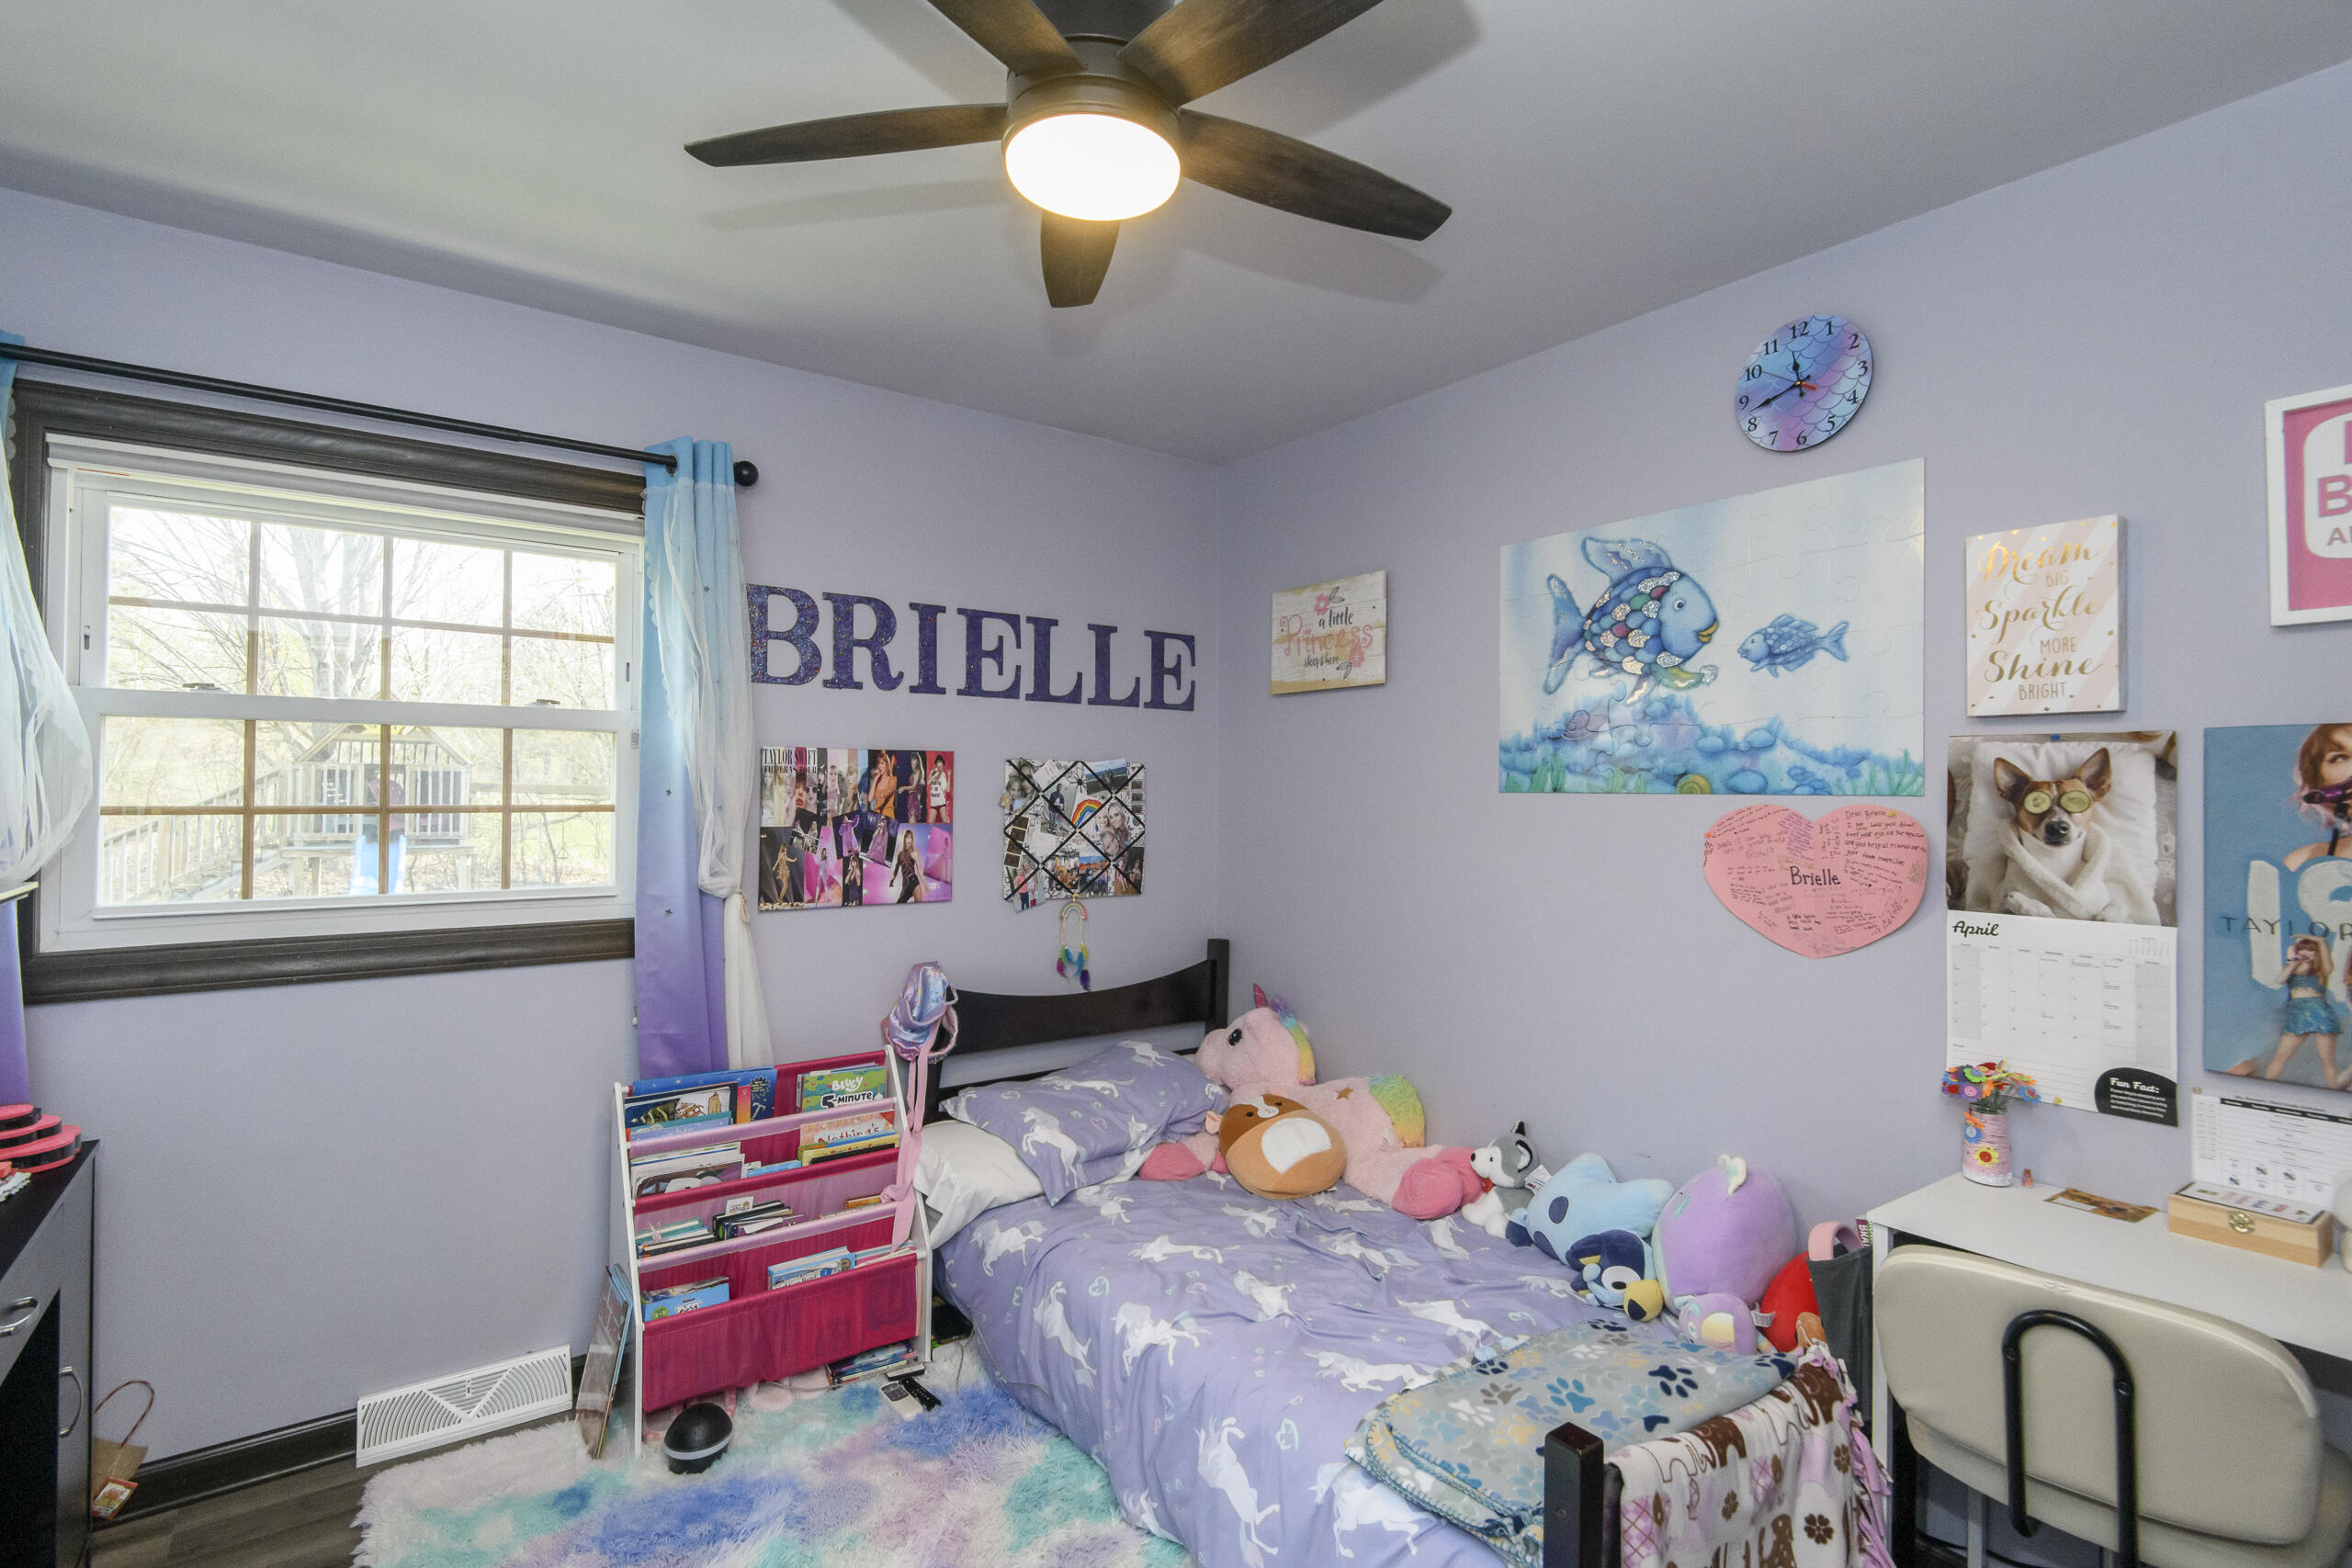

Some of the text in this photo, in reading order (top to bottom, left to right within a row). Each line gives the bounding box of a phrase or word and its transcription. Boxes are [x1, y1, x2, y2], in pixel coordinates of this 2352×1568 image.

[1792, 321, 1810, 340] 12
[1826, 321, 1833, 336] 1
[1763, 339, 1779, 356] 11
[1848, 333, 1860, 350] 2
[1746, 365, 1763, 382] 10
[1858, 360, 1869, 377] 3
[1739, 395, 1749, 411] 9
[1847, 389, 1859, 405] 4
[1747, 416, 1758, 432] 8
[1826, 416, 1836, 432] 5
[1769, 430, 1779, 446] 7
[1796, 429, 1807, 446] 6
[1978, 538, 2108, 585] Dream
[2045, 572, 2069, 588] BIG
[1318, 606, 1354, 629] a little
[1978, 584, 2104, 646] Sparkle
[1279, 614, 1374, 657] Princess
[746, 583, 1196, 712] BRIELLE
[2040, 637, 2078, 655] MORE
[1984, 650, 2104, 683] Shine
[2018, 682, 2066, 701] BRIGHT
[1790, 866, 1841, 886] Brielle
[1952, 920, 1999, 938] April
[2109, 1077, 2131, 1089] Fun
[2132, 1081, 2160, 1094] Fact:
